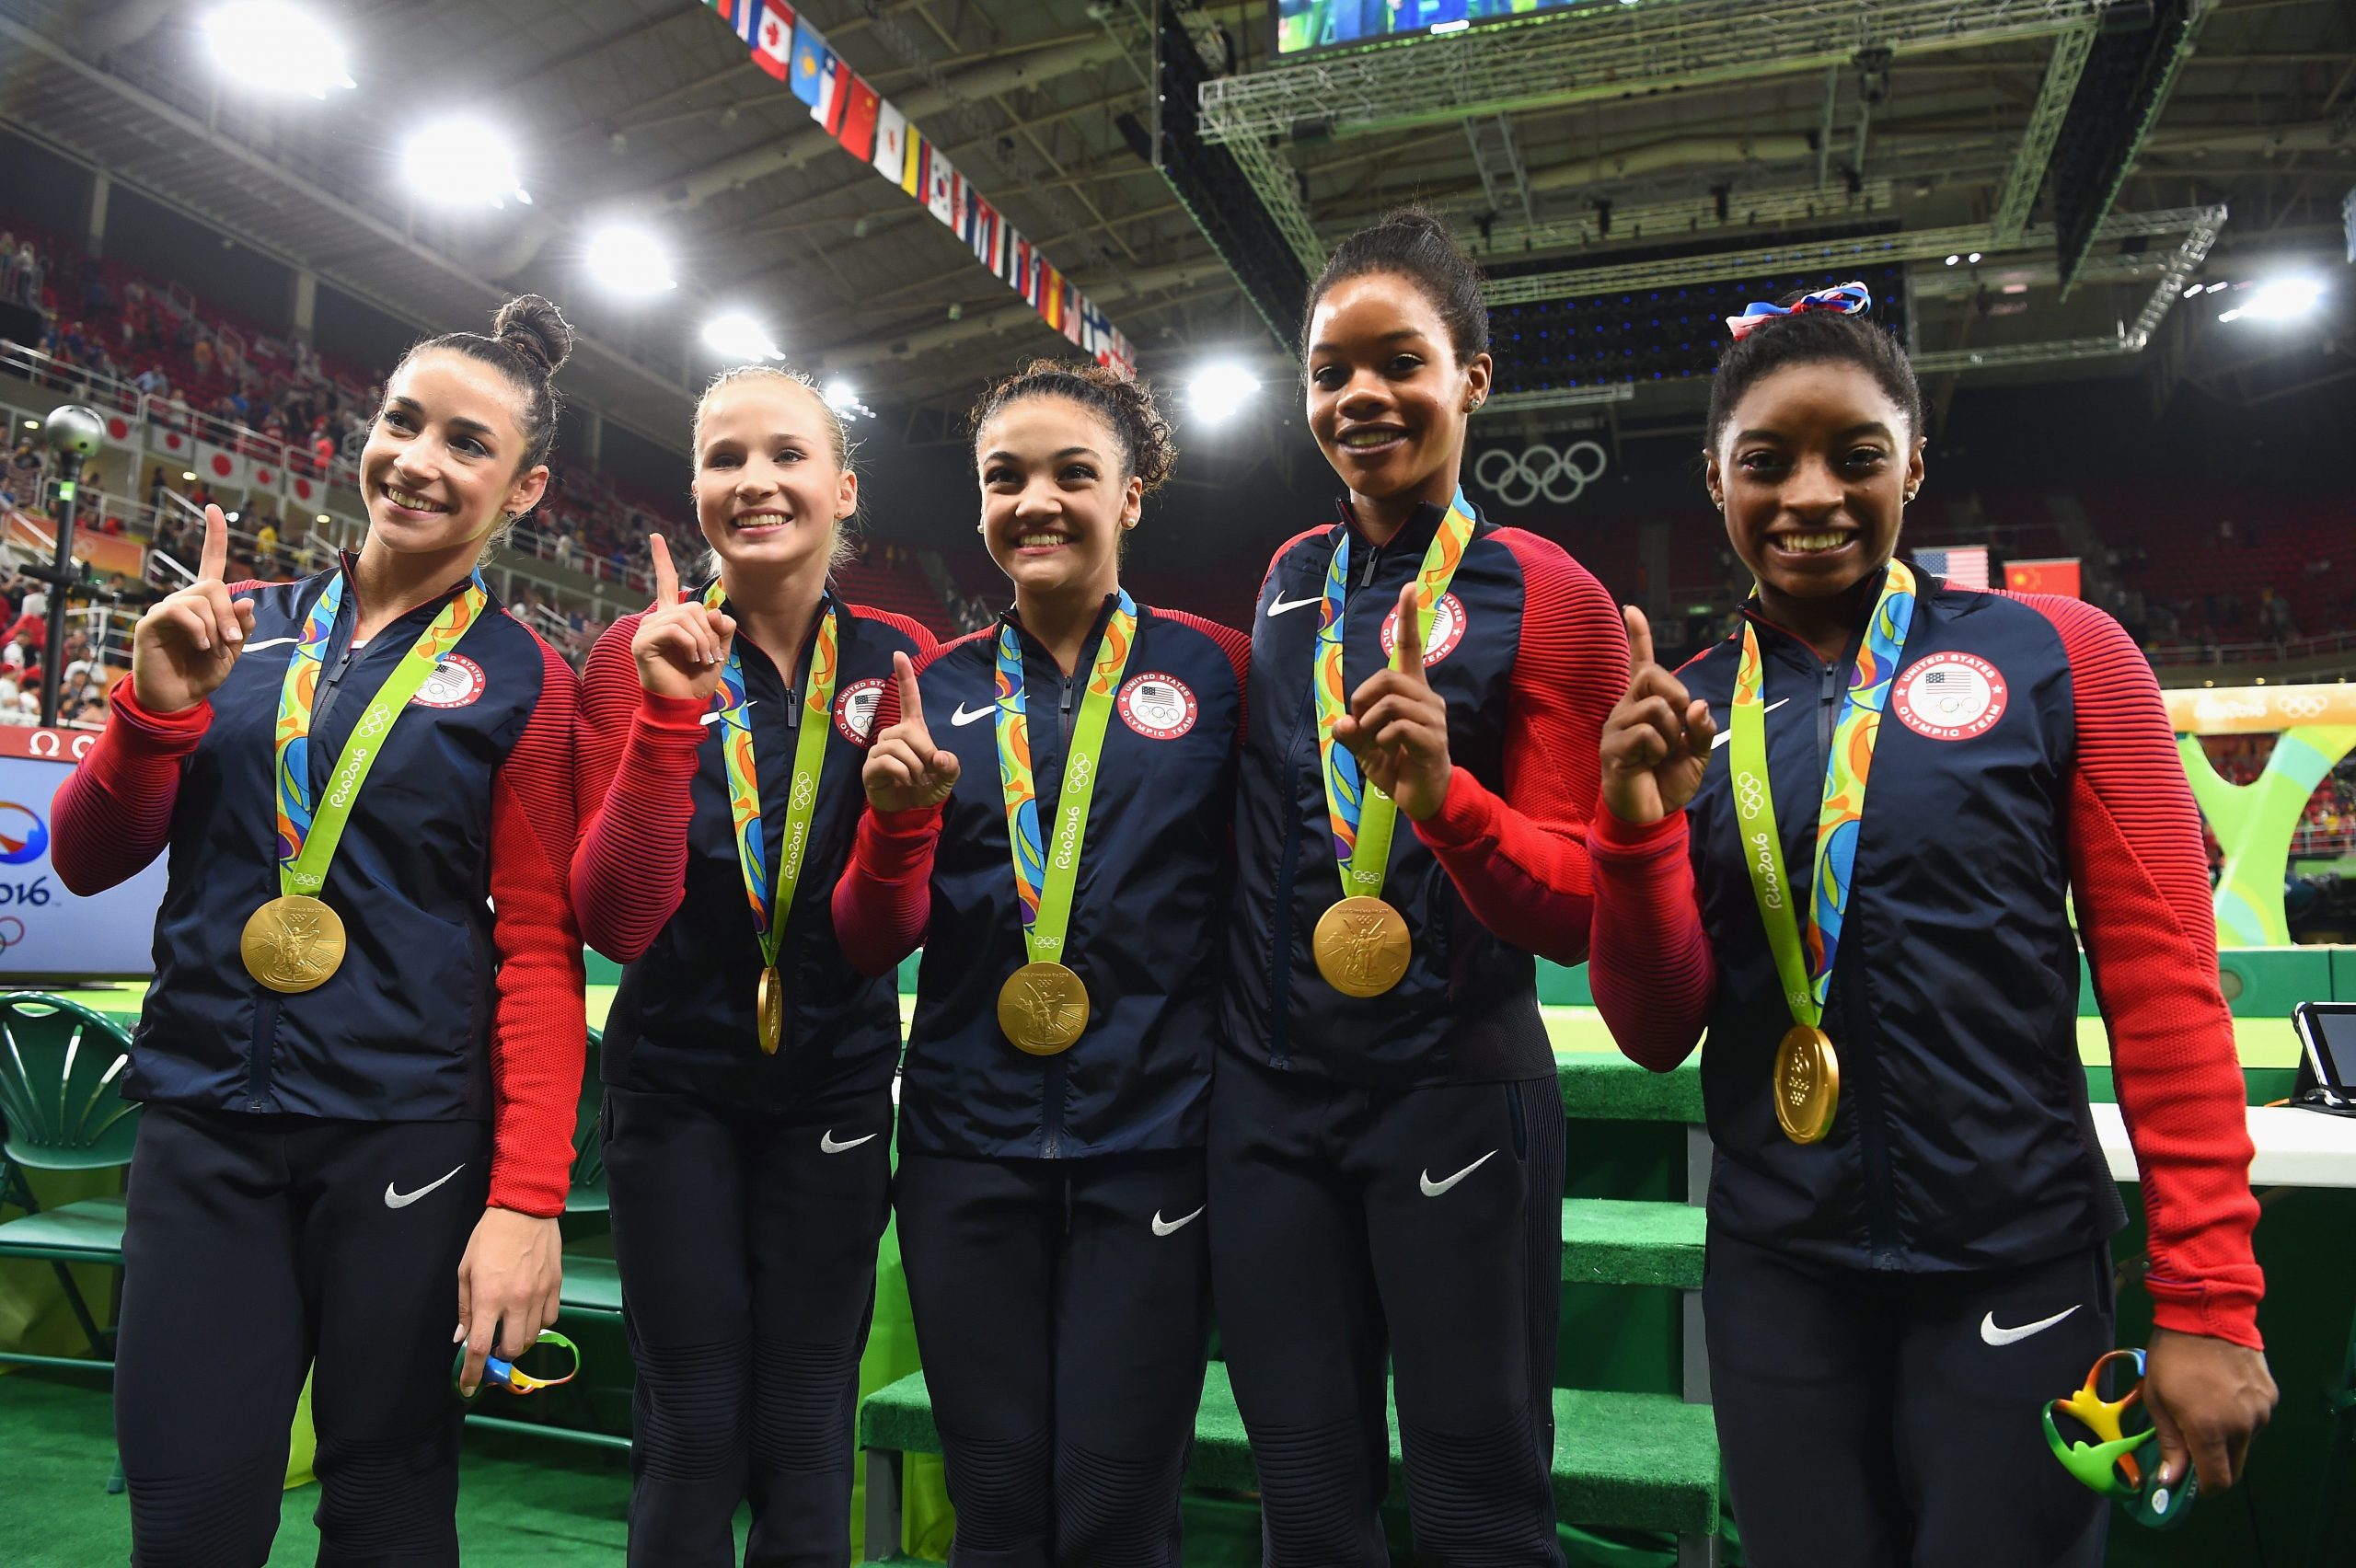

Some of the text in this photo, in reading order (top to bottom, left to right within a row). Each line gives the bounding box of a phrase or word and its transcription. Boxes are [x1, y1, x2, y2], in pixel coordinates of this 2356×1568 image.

[1422, 643, 1451, 664] TEAM
[460, 659, 483, 683] STATES
[1901, 654, 1996, 683] UNITED STATES
[838, 680, 886, 703] UNITED STA
[1125, 674, 1190, 697] UNITED STATES
[442, 698, 470, 708] TEAM
[1123, 709, 1194, 737] OLYMPIC TEAM
[1899, 704, 2001, 737] OLYMPIC TEAM
[840, 722, 864, 744] OLYM
